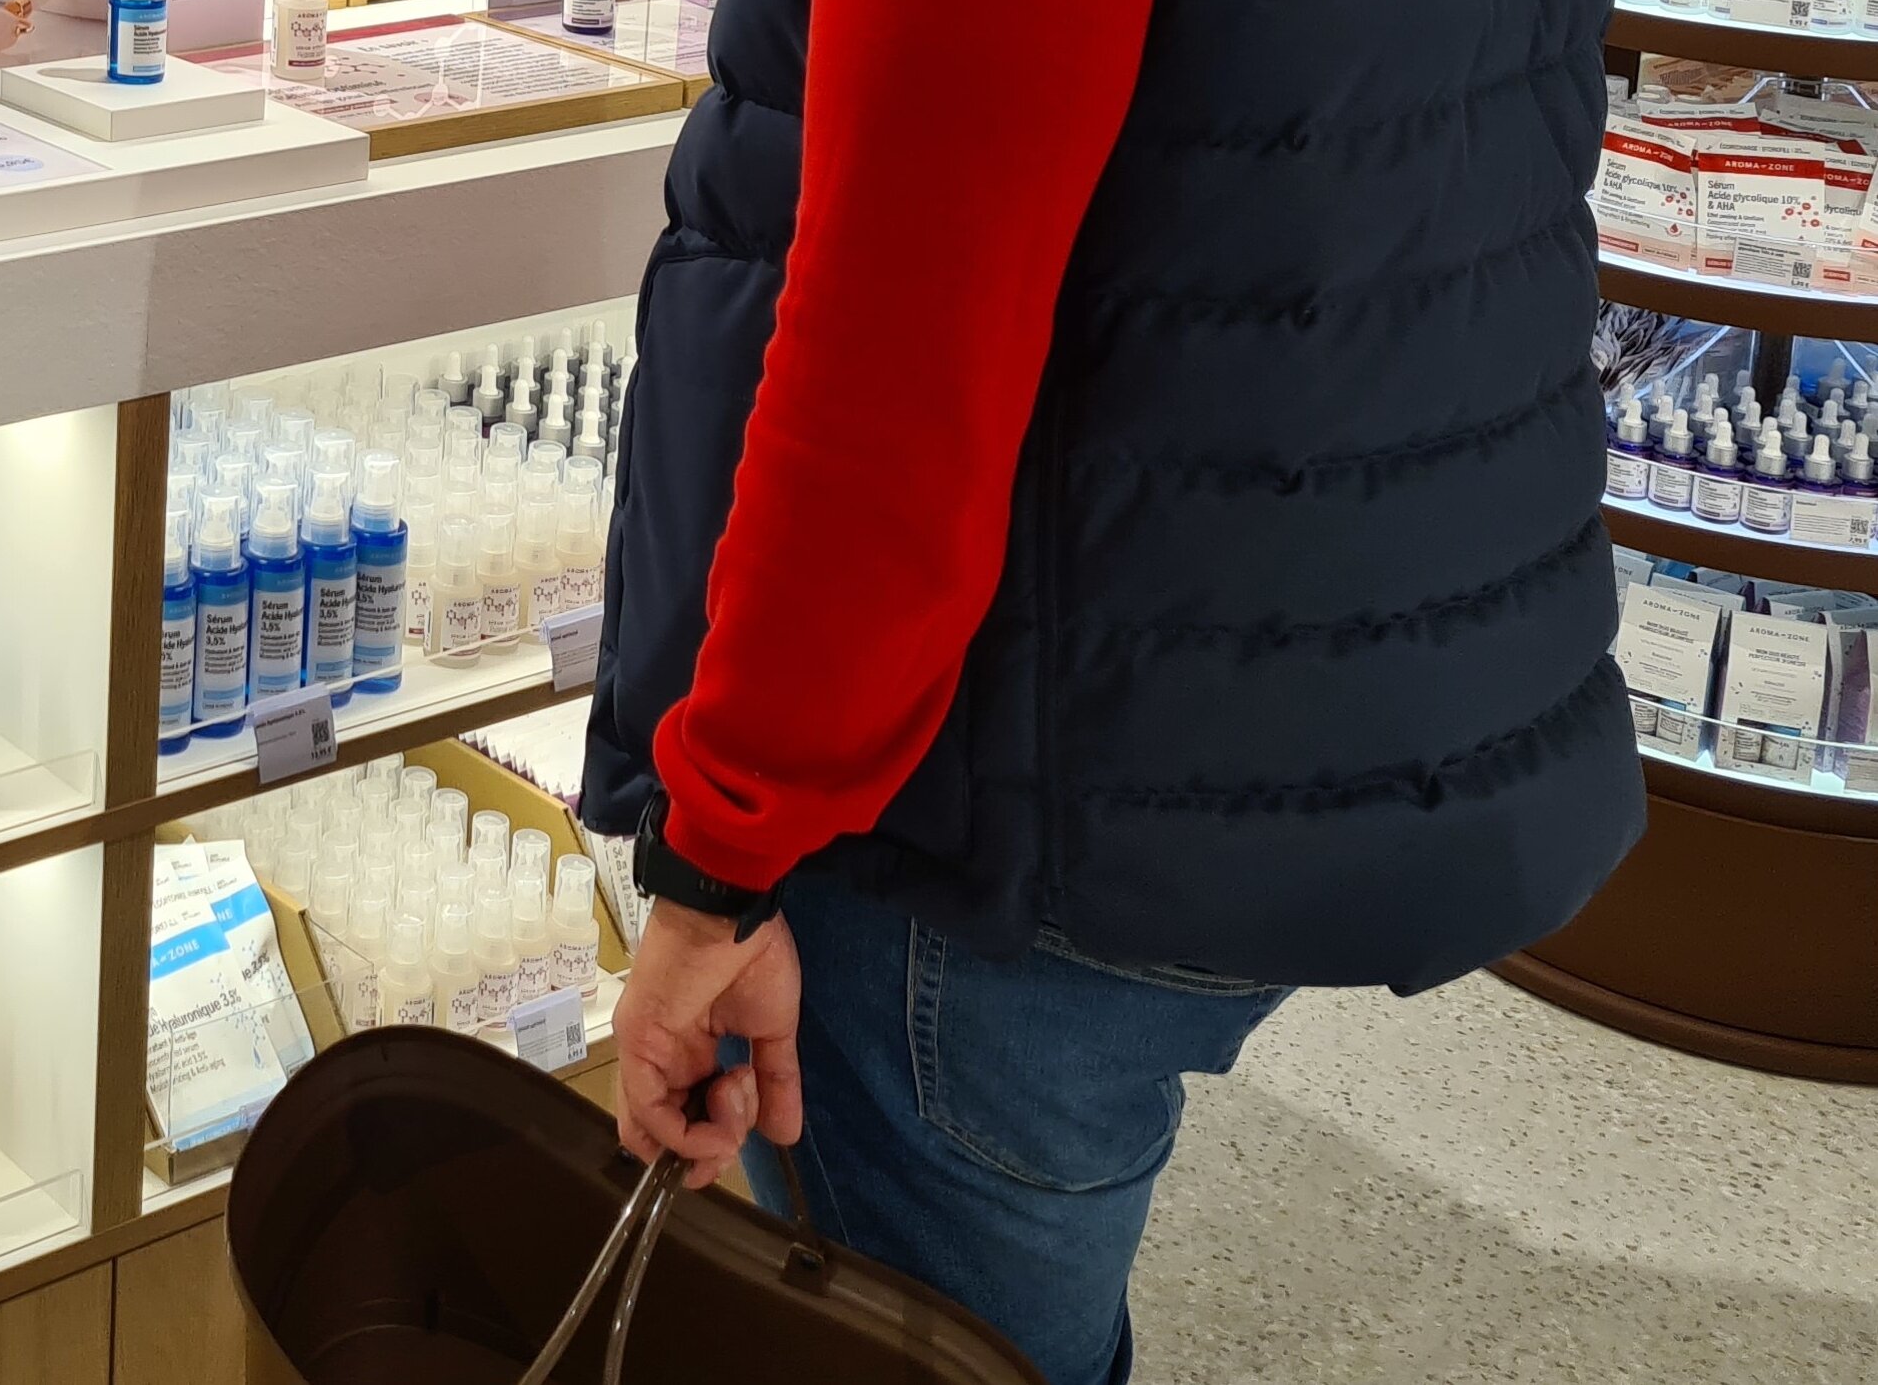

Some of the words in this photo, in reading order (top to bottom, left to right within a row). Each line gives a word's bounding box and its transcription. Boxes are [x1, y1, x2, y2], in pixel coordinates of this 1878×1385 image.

[1708, 180, 1735, 190] Sérum
[1708, 191, 1732, 200] Acide
[1733, 193, 1779, 205] glycolique
[1708, 201, 1714, 209] &
[1717, 202, 1735, 211] AHA
